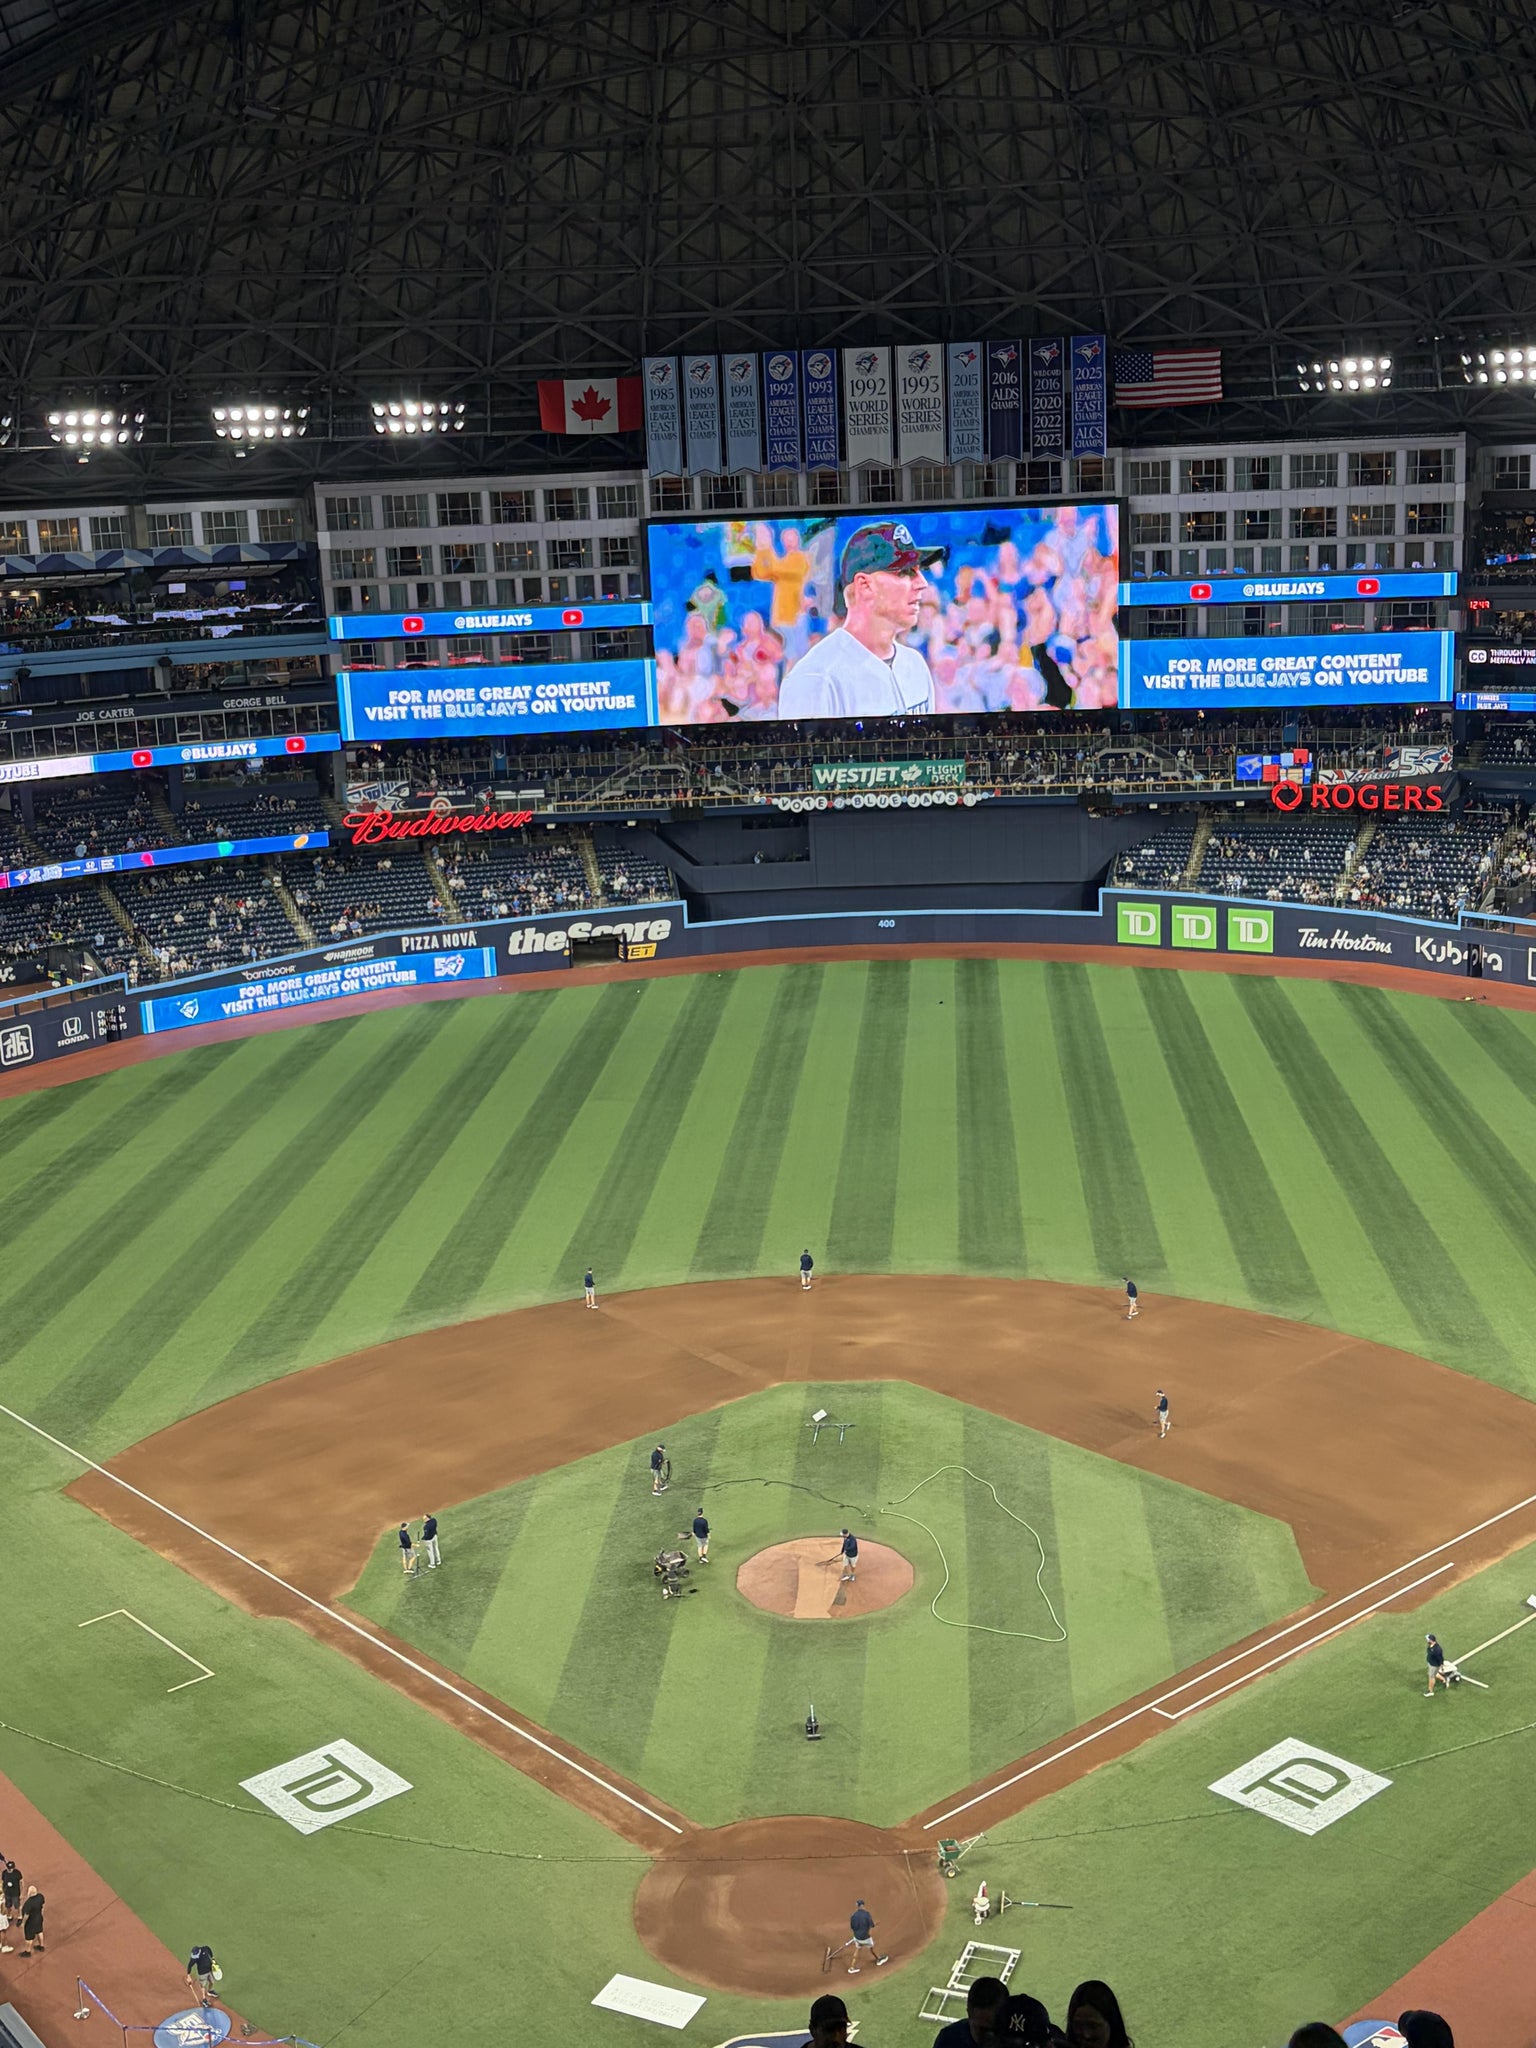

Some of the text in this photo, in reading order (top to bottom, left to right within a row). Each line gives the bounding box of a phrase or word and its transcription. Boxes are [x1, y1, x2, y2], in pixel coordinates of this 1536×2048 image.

[992, 372, 1018, 384] 2016
[1074, 367, 1102, 380] 2025
[902, 376, 940, 394] 1993
[954, 374, 978, 386] 2015
[1034, 378, 1060, 391] 2016
[690, 386, 714, 400] 1989
[730, 385, 752, 398] 1991
[770, 382, 794, 396] 1992
[808, 380, 833, 394] 1993
[850, 378, 886, 397] 1992
[1074, 384, 1102, 392] AMERICAN
[650, 388, 674, 400] 1985
[992, 388, 1019, 400] ALDS
[1074, 392, 1102, 400] LEAGUE
[650, 404, 676, 412] AMERICAN
[848, 400, 888, 412] WORLD
[902, 398, 941, 410] WORLD
[953, 398, 980, 407] LEAGUE
[991, 400, 1020, 410] CHAMPS
[1033, 396, 1062, 410] 2020
[1075, 400, 1102, 412] EAST
[689, 410, 716, 420] LEAGUE
[730, 409, 756, 418] LEAGUE
[769, 407, 796, 416] LEAGUE
[808, 405, 834, 414] LEAGUE
[953, 407, 980, 418] EAST
[650, 412, 677, 420] LEAGUE
[770, 416, 796, 428] EAST
[808, 414, 834, 426] EAST
[848, 413, 889, 426] SERIES
[901, 410, 942, 424] SERIES
[1034, 416, 1062, 428] 2022
[1075, 412, 1103, 420] CHAMPS
[650, 421, 677, 432] EAST
[690, 420, 716, 431] EAST
[730, 418, 756, 429] EAST
[902, 423, 942, 434] CHAMPIONS
[953, 419, 980, 428] CHAMPS
[650, 432, 678, 440] CHAMPS
[690, 431, 717, 440] CHAMPS
[730, 430, 757, 438] CHAMPS
[770, 428, 797, 436] CHAMPS
[808, 426, 835, 434] CHAMPS
[849, 426, 889, 436] CHAMPIONS
[1076, 426, 1104, 439] ALCS
[954, 433, 980, 446] ALDS
[1034, 434, 1062, 447] 2023
[1075, 439, 1104, 448] CHAMPS
[771, 442, 798, 454] ALCS
[810, 440, 836, 452] ALCS
[953, 446, 980, 454] CHAMPS
[770, 454, 798, 464] CHAMPS
[809, 452, 836, 462] CHAMPS
[1242, 582, 1325, 597] @BLUEJAYS
[454, 614, 533, 629] @BLUEJAYS
[1168, 652, 1402, 674] FOR MORE GREAT CONTENT
[1142, 667, 1428, 690] VISIT THE BLUE JAYS ON YOUTUBE
[388, 681, 612, 705] FOR MORE GREAT CONTENT
[223, 696, 287, 709] GEORGE BELL
[364, 695, 636, 722] VISIT THE BLUE JAYS ON YOUTUBE
[76, 708, 135, 722] JOE CARTER
[181, 742, 258, 761] @BLUEJAYS
[926, 764, 964, 775] FLIGHT
[814, 766, 900, 786] WESTJET
[780, 791, 957, 811] VOTE BLUE JAYS
[1312, 784, 1443, 812] ROGERS
[342, 805, 533, 846] Budweiser
[878, 919, 896, 928] 400
[1122, 910, 1156, 936] TD
[1176, 913, 1212, 940] TD
[1232, 916, 1269, 944] TD
[401, 930, 478, 953] PIZZA NOVA
[1298, 928, 1392, 954] Tim Hortons
[244, 965, 296, 980] bambooHR
[239, 960, 398, 999] FOR MORE GREAT CONTENT
[221, 998, 256, 1016] VISIT
[256, 994, 279, 1008] THE
[310, 982, 340, 1000] JAYS
[341, 978, 360, 992] ON
[361, 970, 416, 987] YOUTUBE
[57, 1033, 90, 1048] HONDA
[281, 1754, 374, 1812] TD
[1239, 1758, 1351, 1810] TD
[1009, 2012, 1026, 2032] NY
